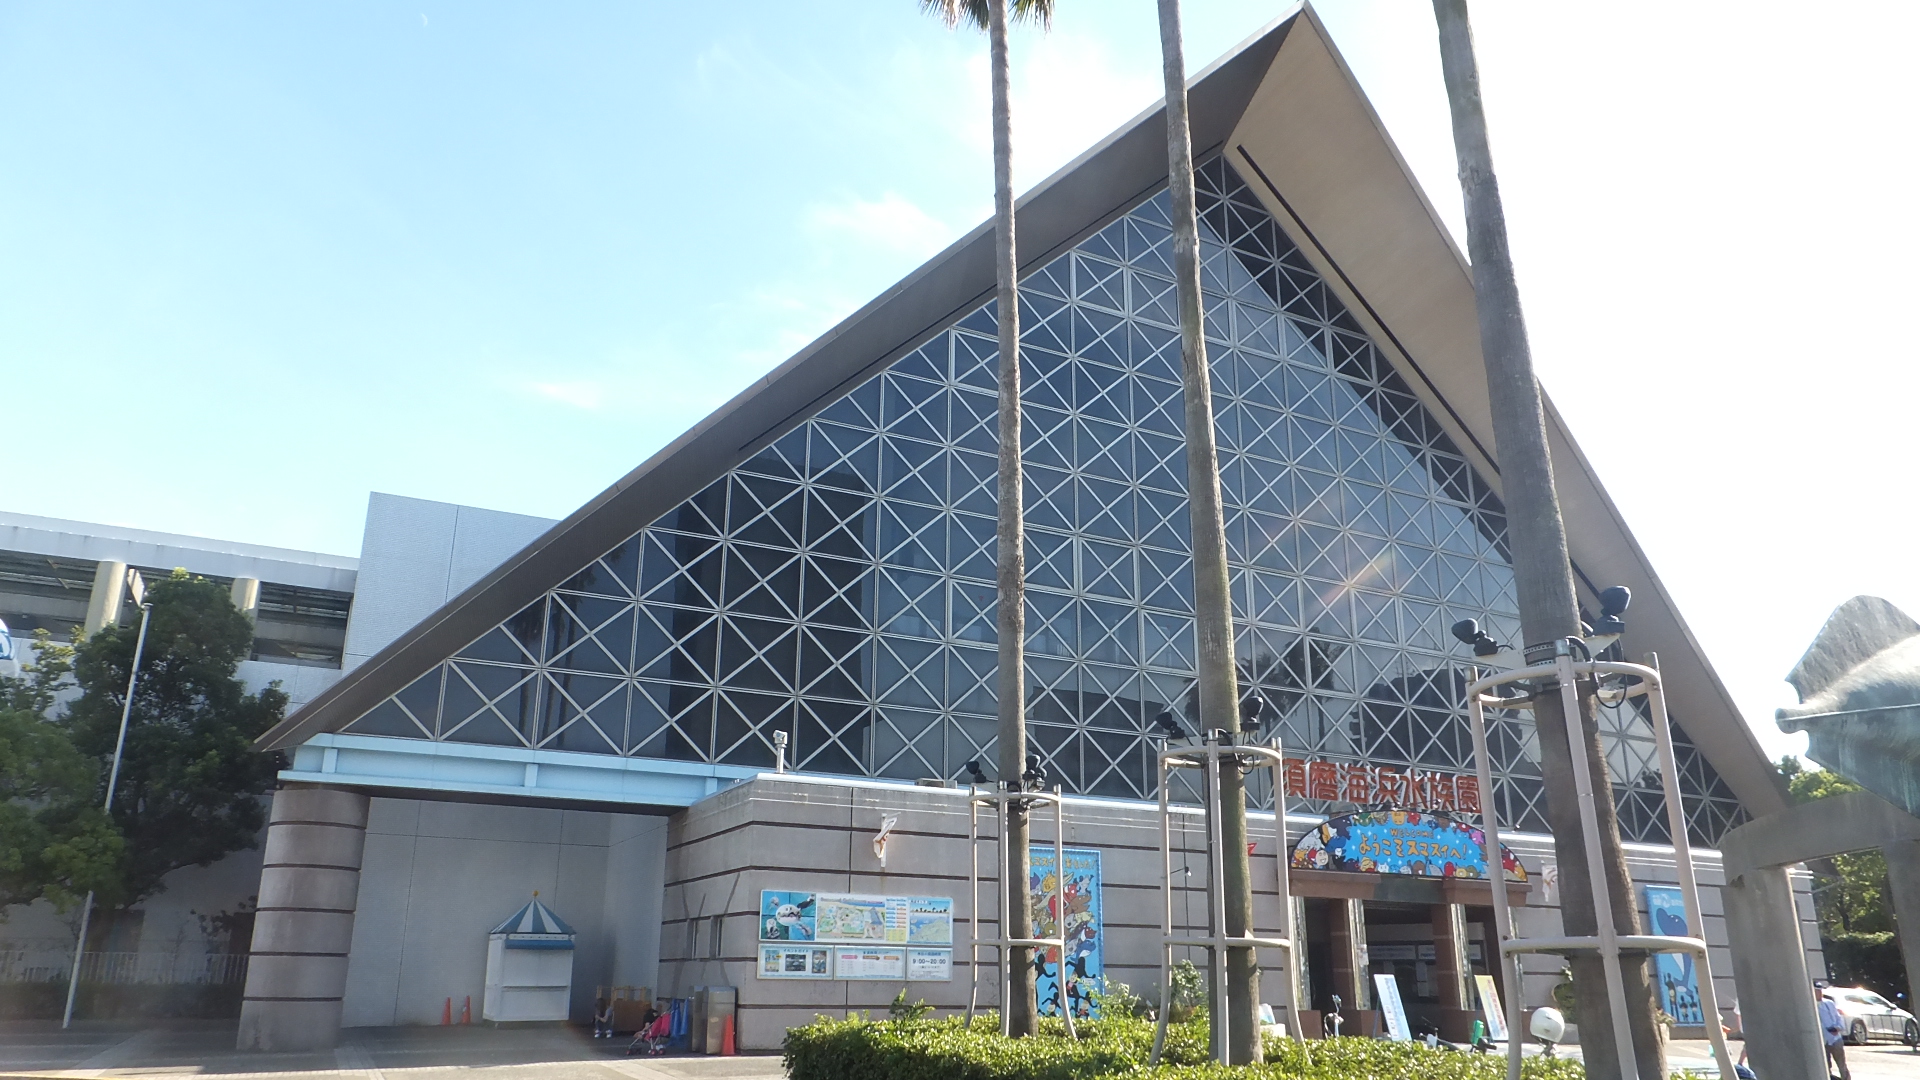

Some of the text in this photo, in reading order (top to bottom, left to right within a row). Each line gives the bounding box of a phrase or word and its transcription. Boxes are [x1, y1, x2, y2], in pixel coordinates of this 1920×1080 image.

[1282, 757, 1482, 813] 須磨海浜水族園
[1390, 828, 1434, 839] WELCOME
